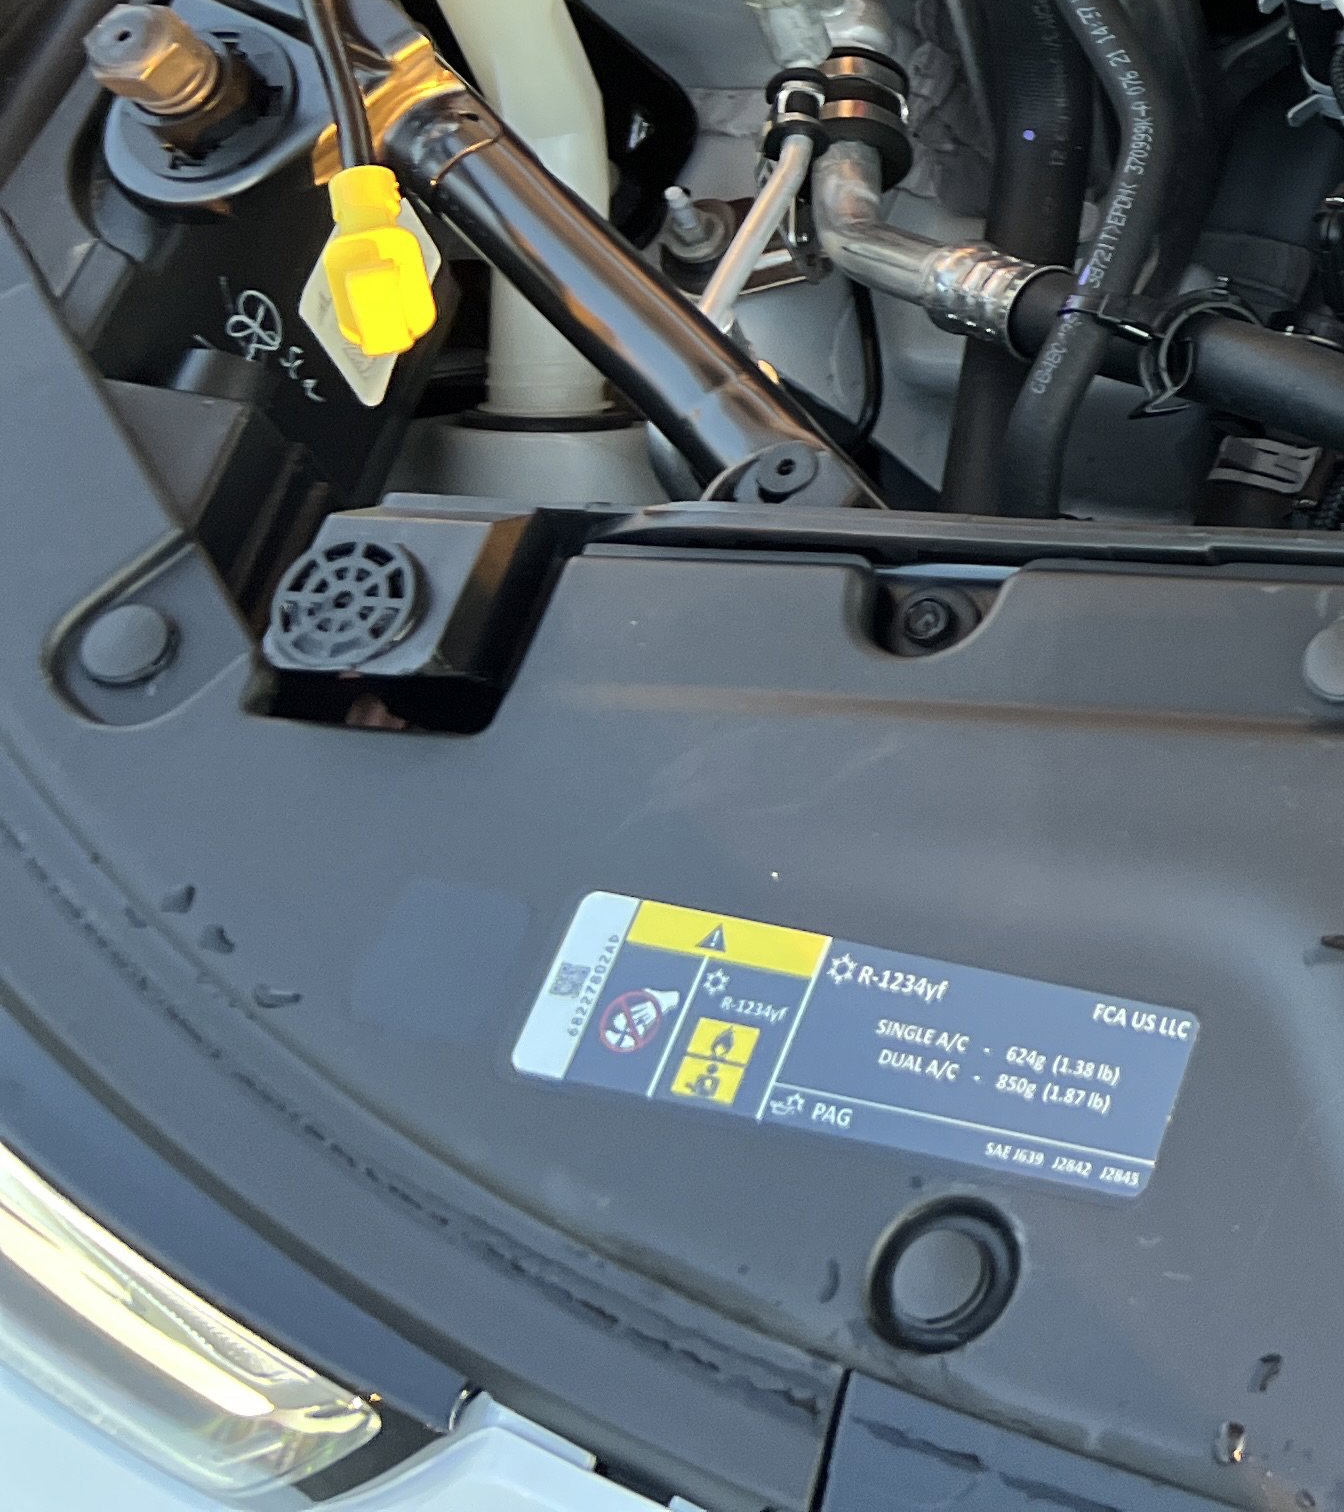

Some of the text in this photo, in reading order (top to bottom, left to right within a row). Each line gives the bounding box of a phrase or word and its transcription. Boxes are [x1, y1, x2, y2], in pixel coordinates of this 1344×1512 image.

[857, 965, 948, 1002] R-1234yf
[721, 997, 789, 1022] R-1234yf
[1093, 1003, 1191, 1040] FCA US LLC
[876, 1019, 932, 1046] SINGLE
[935, 1031, 968, 1054] A/C
[1006, 1046, 1046, 1072] 624g
[1052, 1053, 1094, 1079] (1.38
[1097, 1062, 1122, 1086] lb)
[878, 1049, 924, 1073] DUAL
[927, 1058, 960, 1082] A/C
[995, 1073, 1035, 1098] 850g
[1041, 1080, 1088, 1105] (1.87
[1088, 1090, 1110, 1114] lb)
[811, 1102, 851, 1128] PAG
[984, 1141, 1012, 1160] SAE
[1012, 1146, 1045, 1166] J639
[1051, 1155, 1092, 1177] J2842
